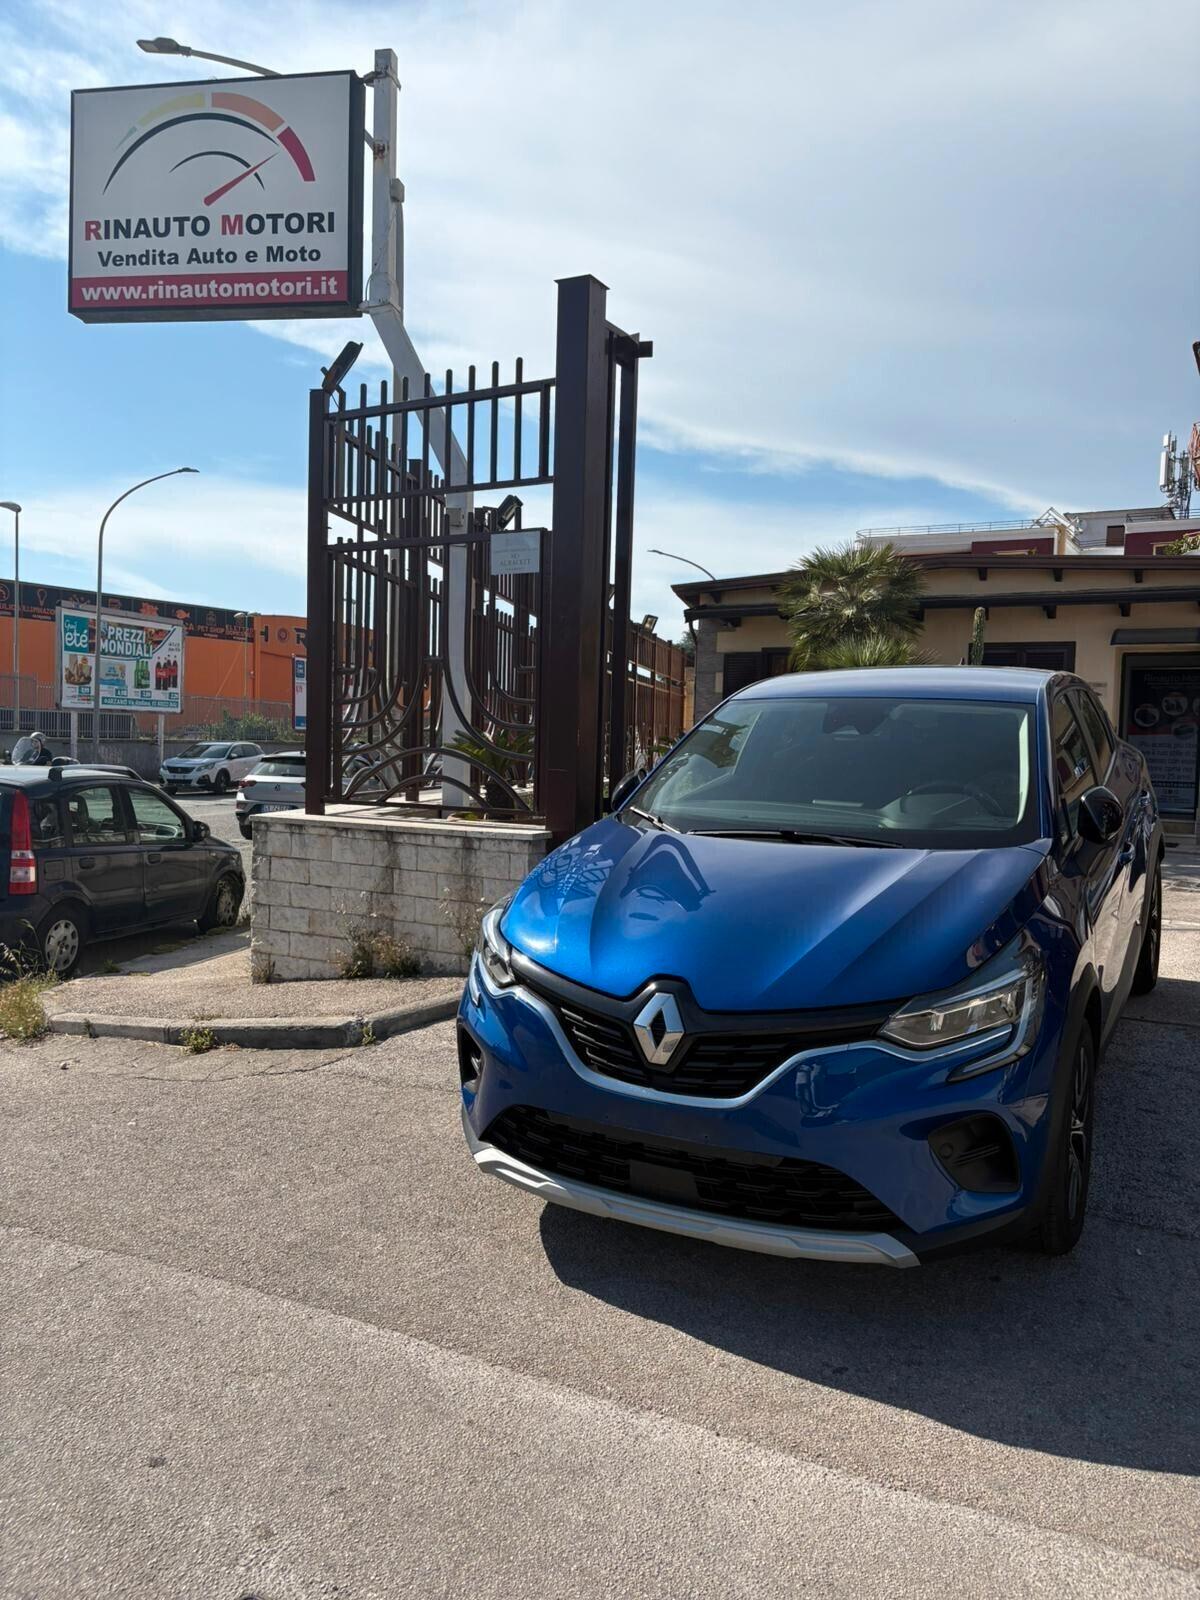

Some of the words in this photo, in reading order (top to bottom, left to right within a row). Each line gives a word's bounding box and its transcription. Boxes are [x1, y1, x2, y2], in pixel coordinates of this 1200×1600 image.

[84, 215, 210, 241] RINAUTO
[221, 212, 335, 236] MOTORI
[98, 249, 179, 267] Vendita
[186, 247, 237, 265] Auto
[245, 250, 258, 263] e
[266, 245, 322, 262] Moto
[81, 276, 337, 301] www.rinautomotori.it
[65, 630, 89, 648] eté
[108, 625, 146, 643] PREZZI
[100, 638, 153, 657] MONDIALI
